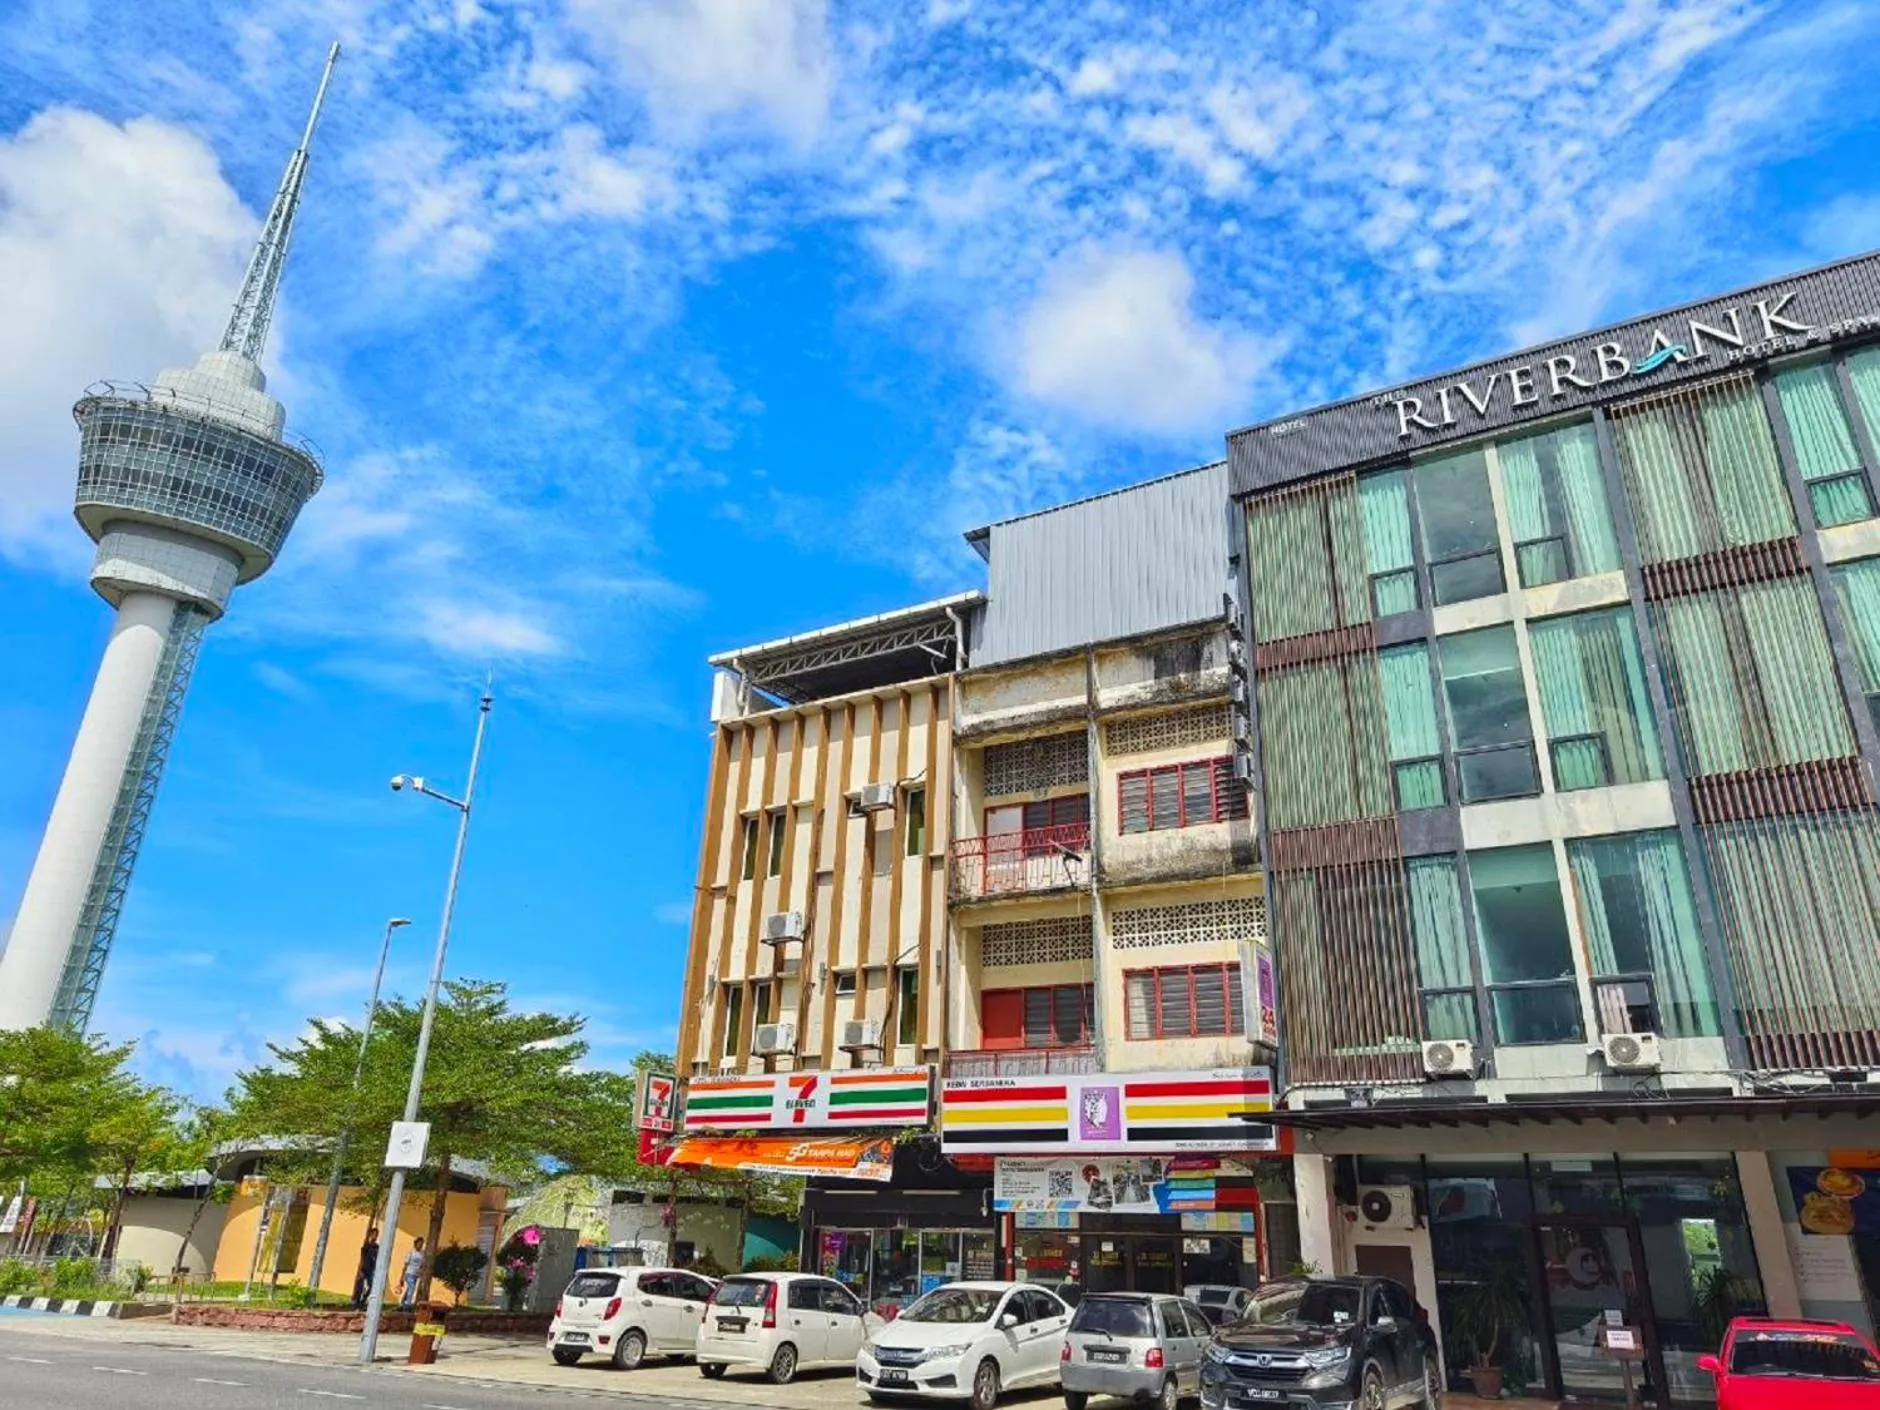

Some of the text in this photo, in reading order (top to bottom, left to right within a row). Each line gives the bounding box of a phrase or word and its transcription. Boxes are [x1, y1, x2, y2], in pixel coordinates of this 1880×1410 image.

[1394, 290, 1818, 437] RIVERBANK
[1727, 333, 1797, 361] HOTEL
[1271, 419, 1308, 436] HOTEL
[652, 1080, 670, 1117] 7
[789, 1075, 818, 1123] 7
